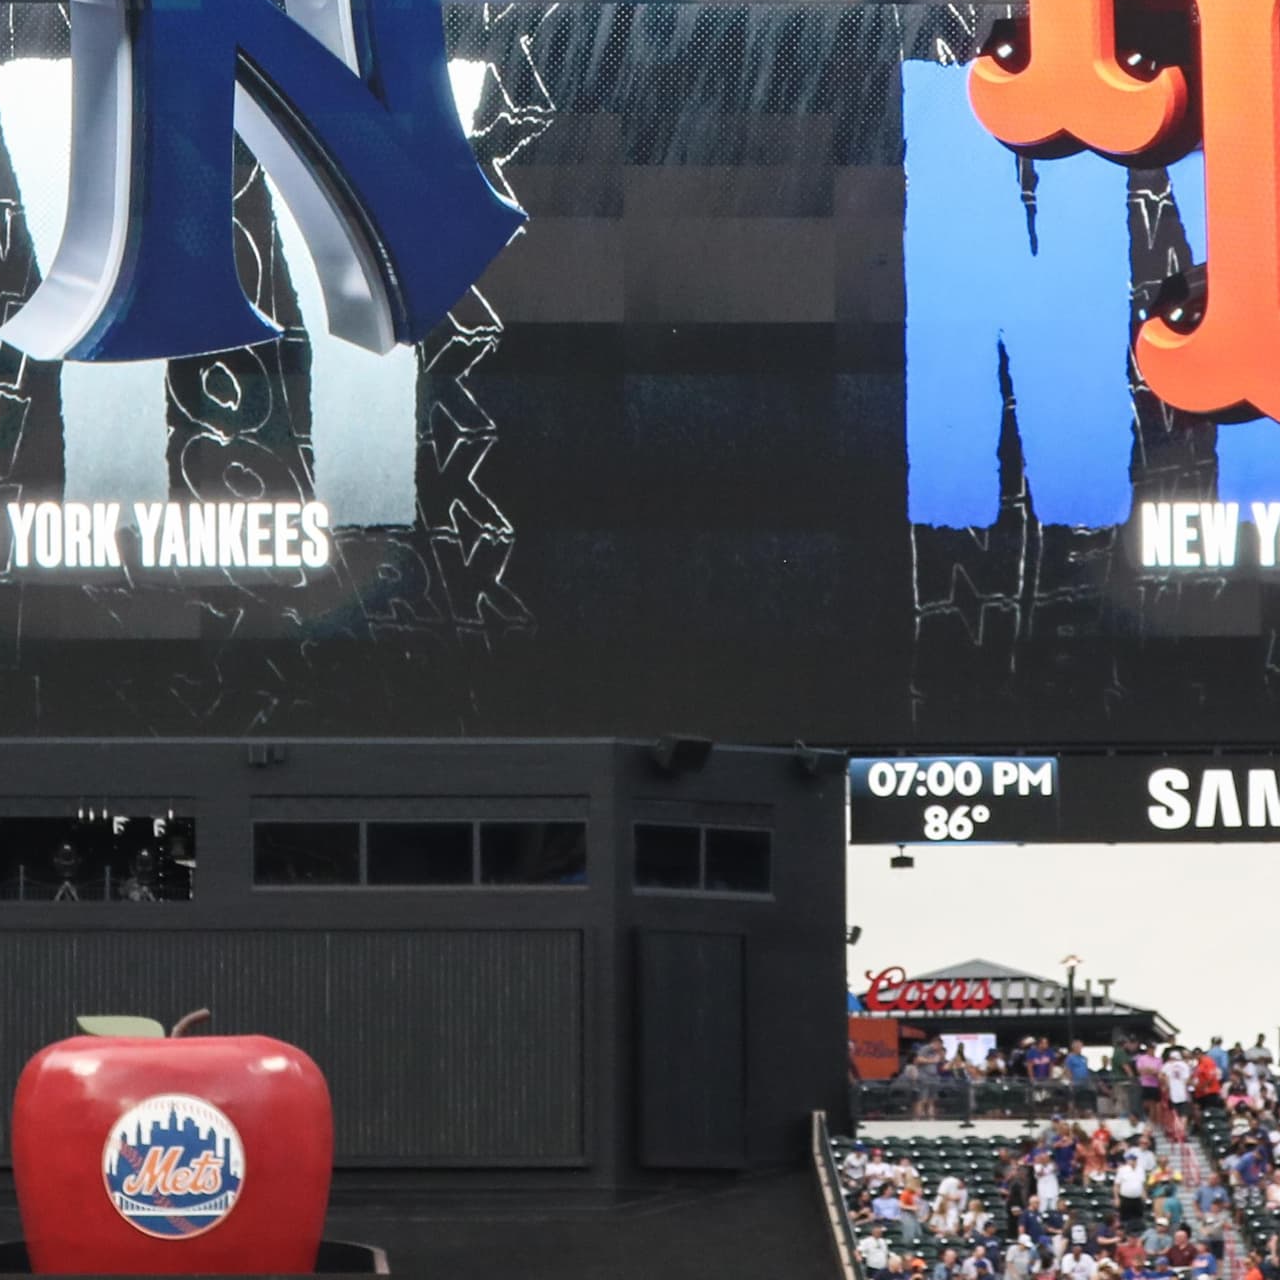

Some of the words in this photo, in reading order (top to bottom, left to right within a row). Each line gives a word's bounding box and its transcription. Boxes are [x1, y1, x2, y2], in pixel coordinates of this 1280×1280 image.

[7, 502, 120, 568] YORK
[134, 502, 330, 568] YANKEES
[1141, 501, 1239, 568] NEW
[867, 761, 982, 797] 07:00
[992, 761, 1053, 797] PM
[923, 804, 990, 841] 86°
[865, 966, 994, 1011] Coors
[123, 1146, 224, 1195] Mets
